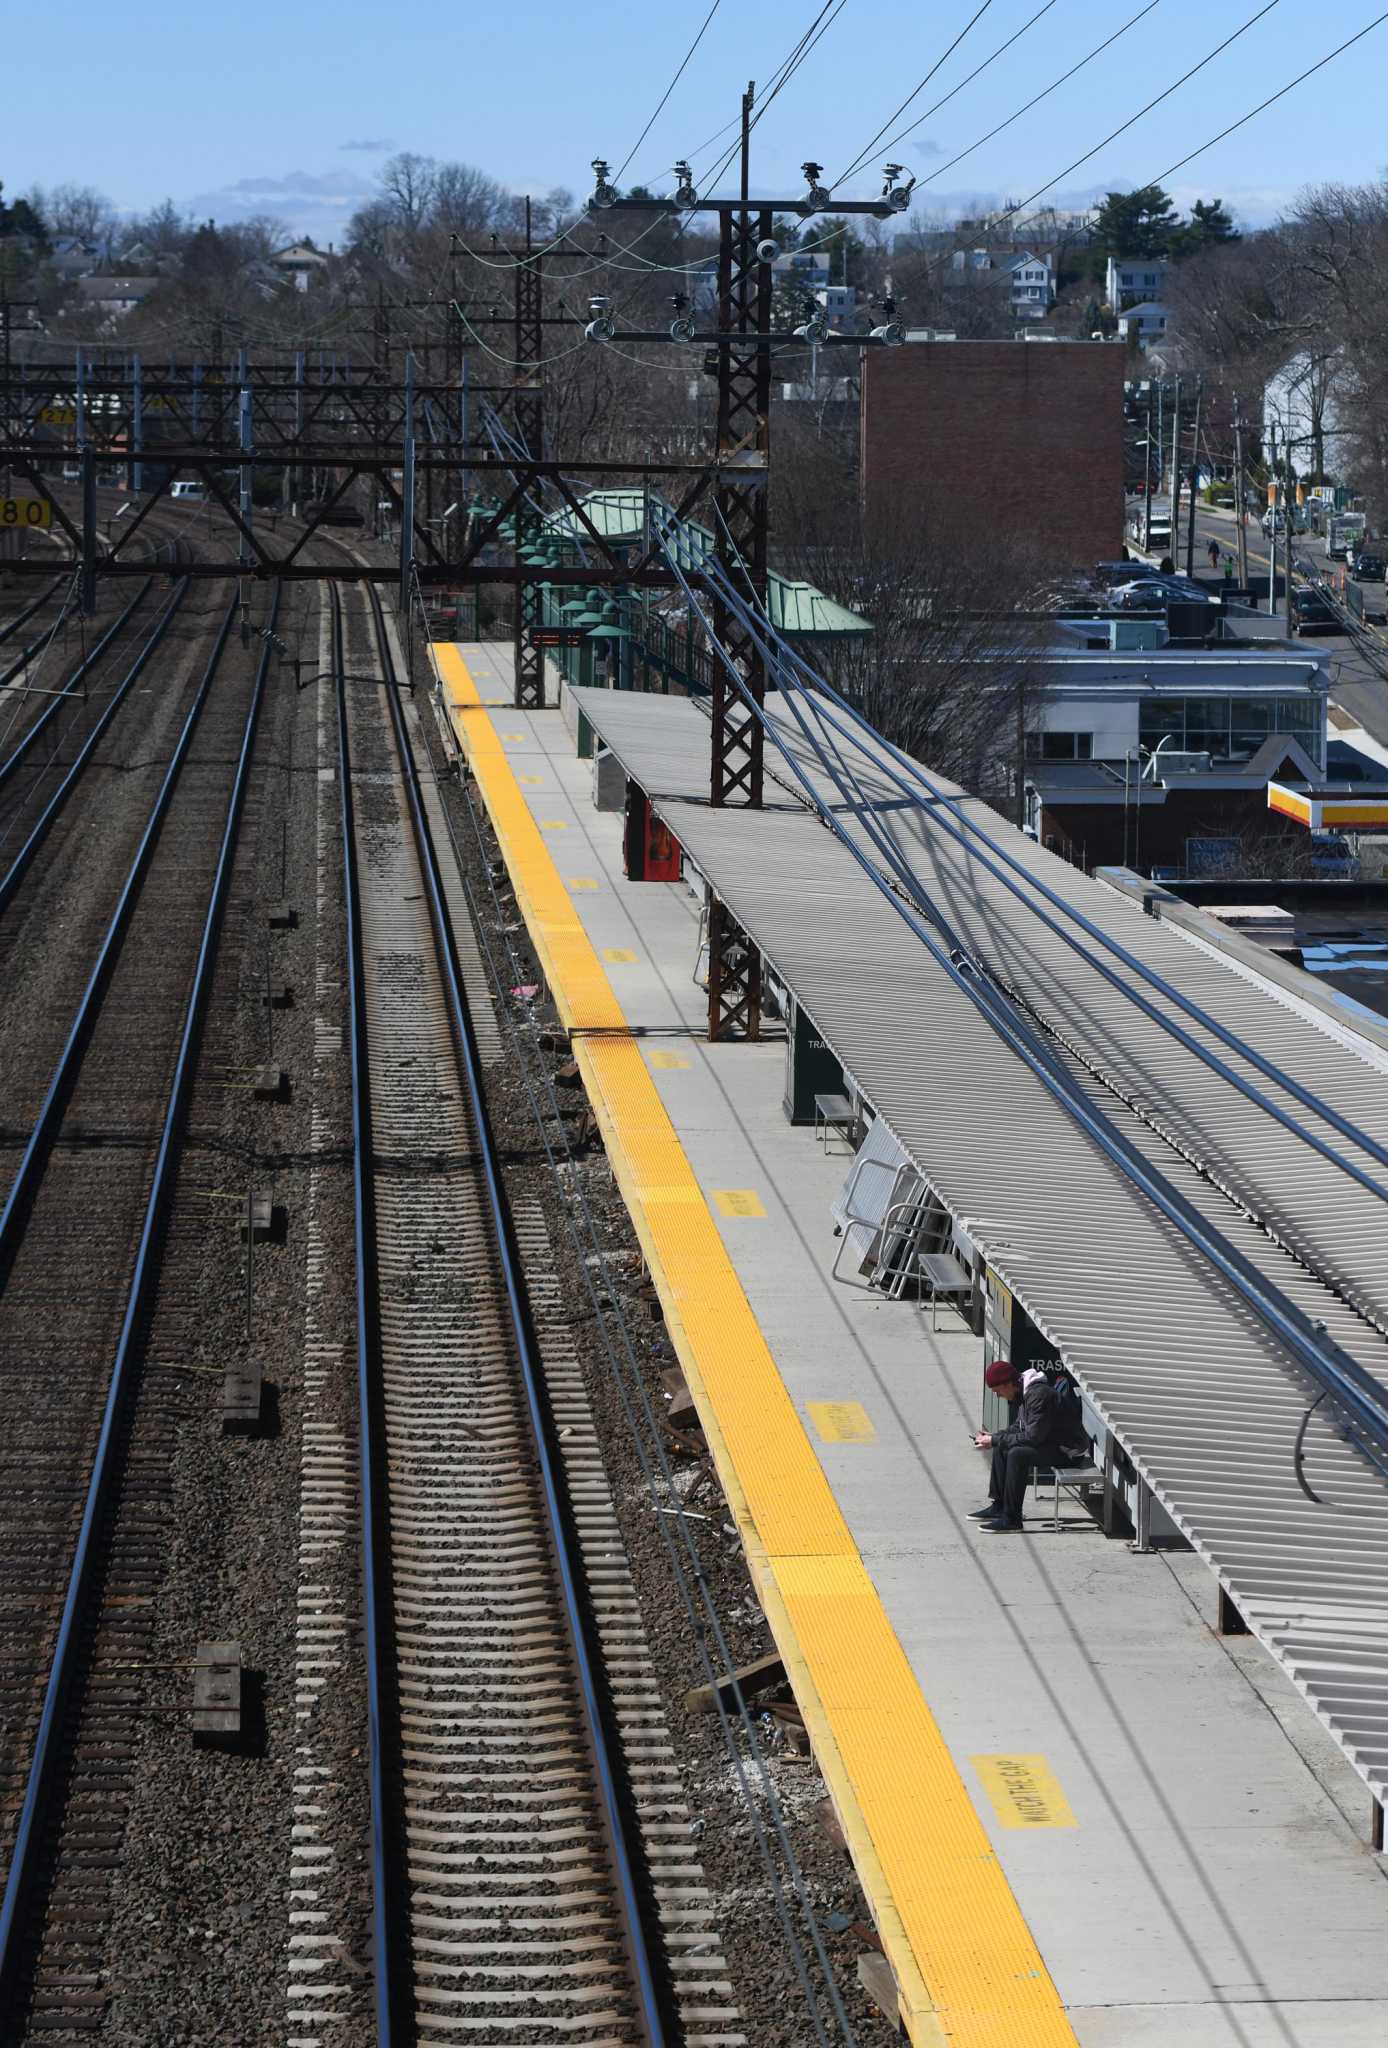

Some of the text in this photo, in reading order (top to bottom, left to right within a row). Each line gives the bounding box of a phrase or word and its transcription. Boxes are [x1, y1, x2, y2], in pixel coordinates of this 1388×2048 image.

[3, 501, 42, 523] 80
[807, 1040, 828, 1049] TRA
[996, 1760, 1056, 1823] WATCH THE GAP
